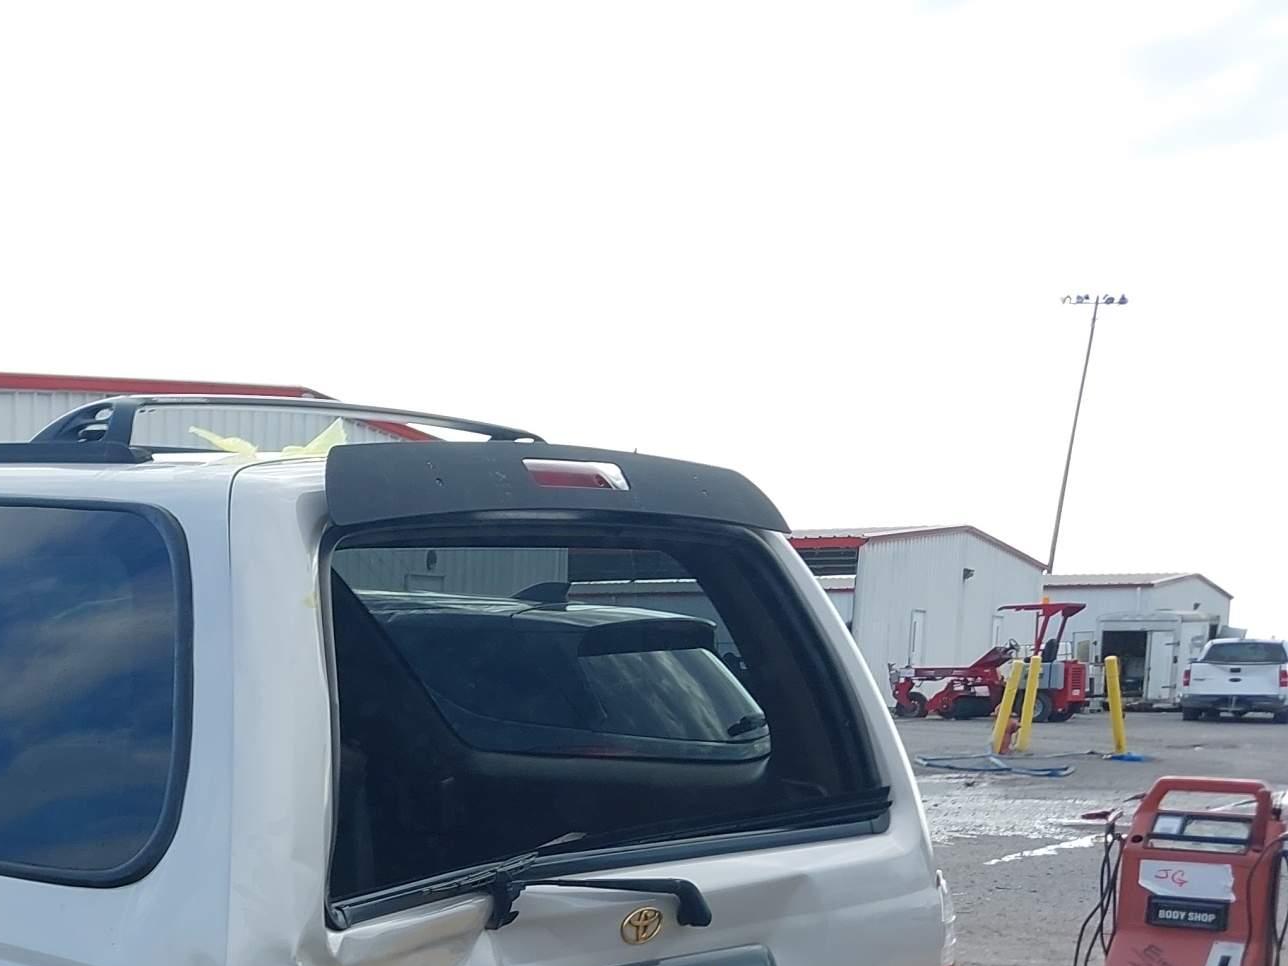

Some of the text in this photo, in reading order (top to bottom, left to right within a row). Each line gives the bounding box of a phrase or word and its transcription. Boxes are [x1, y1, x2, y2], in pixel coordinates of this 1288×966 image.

[1154, 868, 1189, 887] JG
[1158, 909, 1217, 923] BODY SHOP
